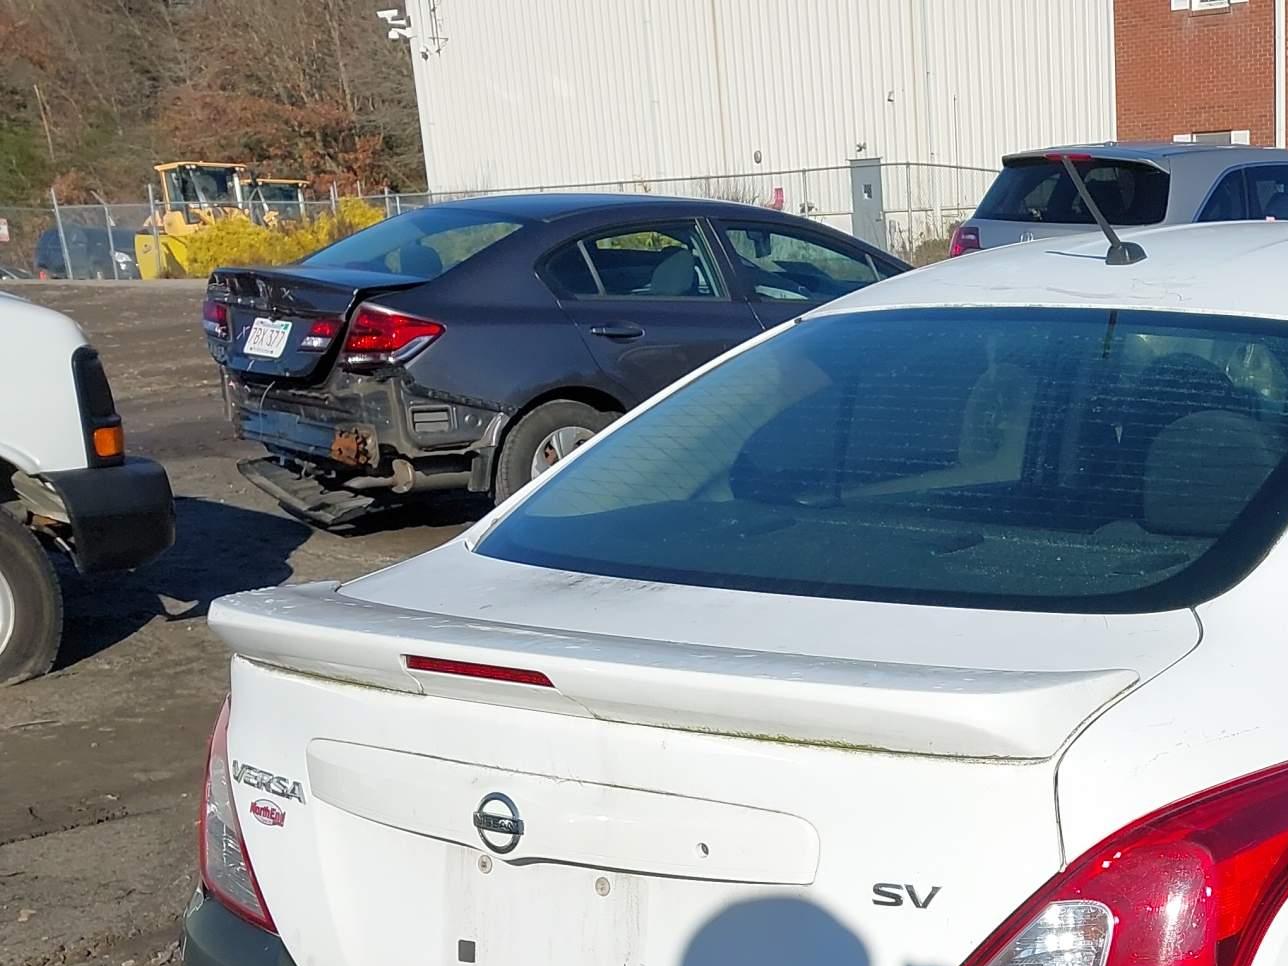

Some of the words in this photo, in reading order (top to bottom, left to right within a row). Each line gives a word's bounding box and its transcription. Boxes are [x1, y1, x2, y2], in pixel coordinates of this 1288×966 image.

[232, 760, 307, 806] VERSA
[474, 813, 519, 833] NISSAN
[872, 882, 943, 910] SV
